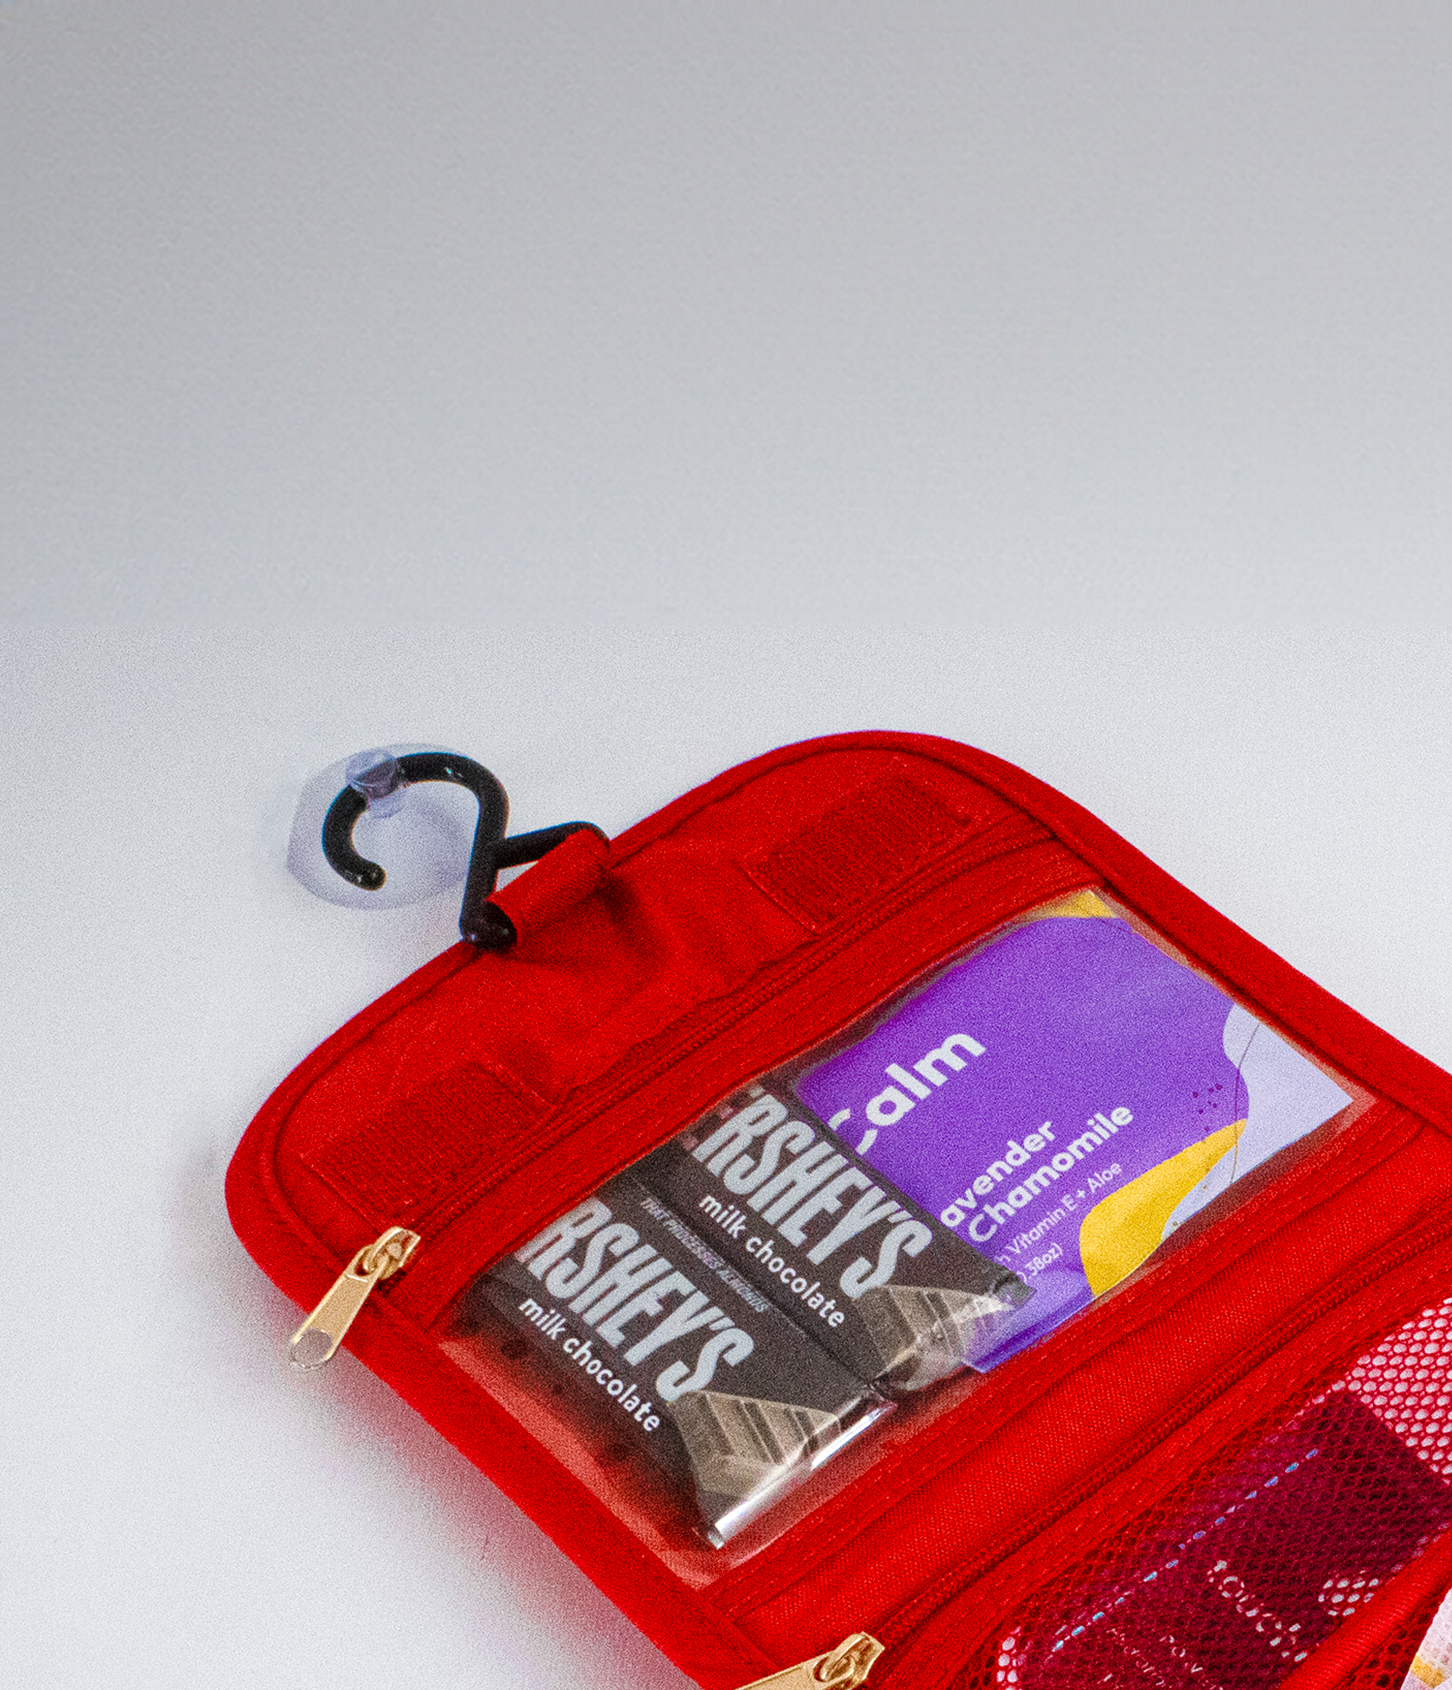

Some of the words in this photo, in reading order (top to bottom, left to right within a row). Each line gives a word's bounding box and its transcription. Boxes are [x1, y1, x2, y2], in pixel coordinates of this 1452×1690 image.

[684, 1085, 932, 1299] RSHEY'S
[969, 1107, 1133, 1242] Chamomile
[1006, 1207, 1065, 1254] Vitamin
[1061, 1194, 1078, 1211] E
[1087, 1163, 1122, 1193] Aloe
[699, 1195, 746, 1238] milk
[746, 1237, 845, 1327] chocolate
[518, 1298, 566, 1341] milk
[563, 1337, 660, 1431] chocolate
